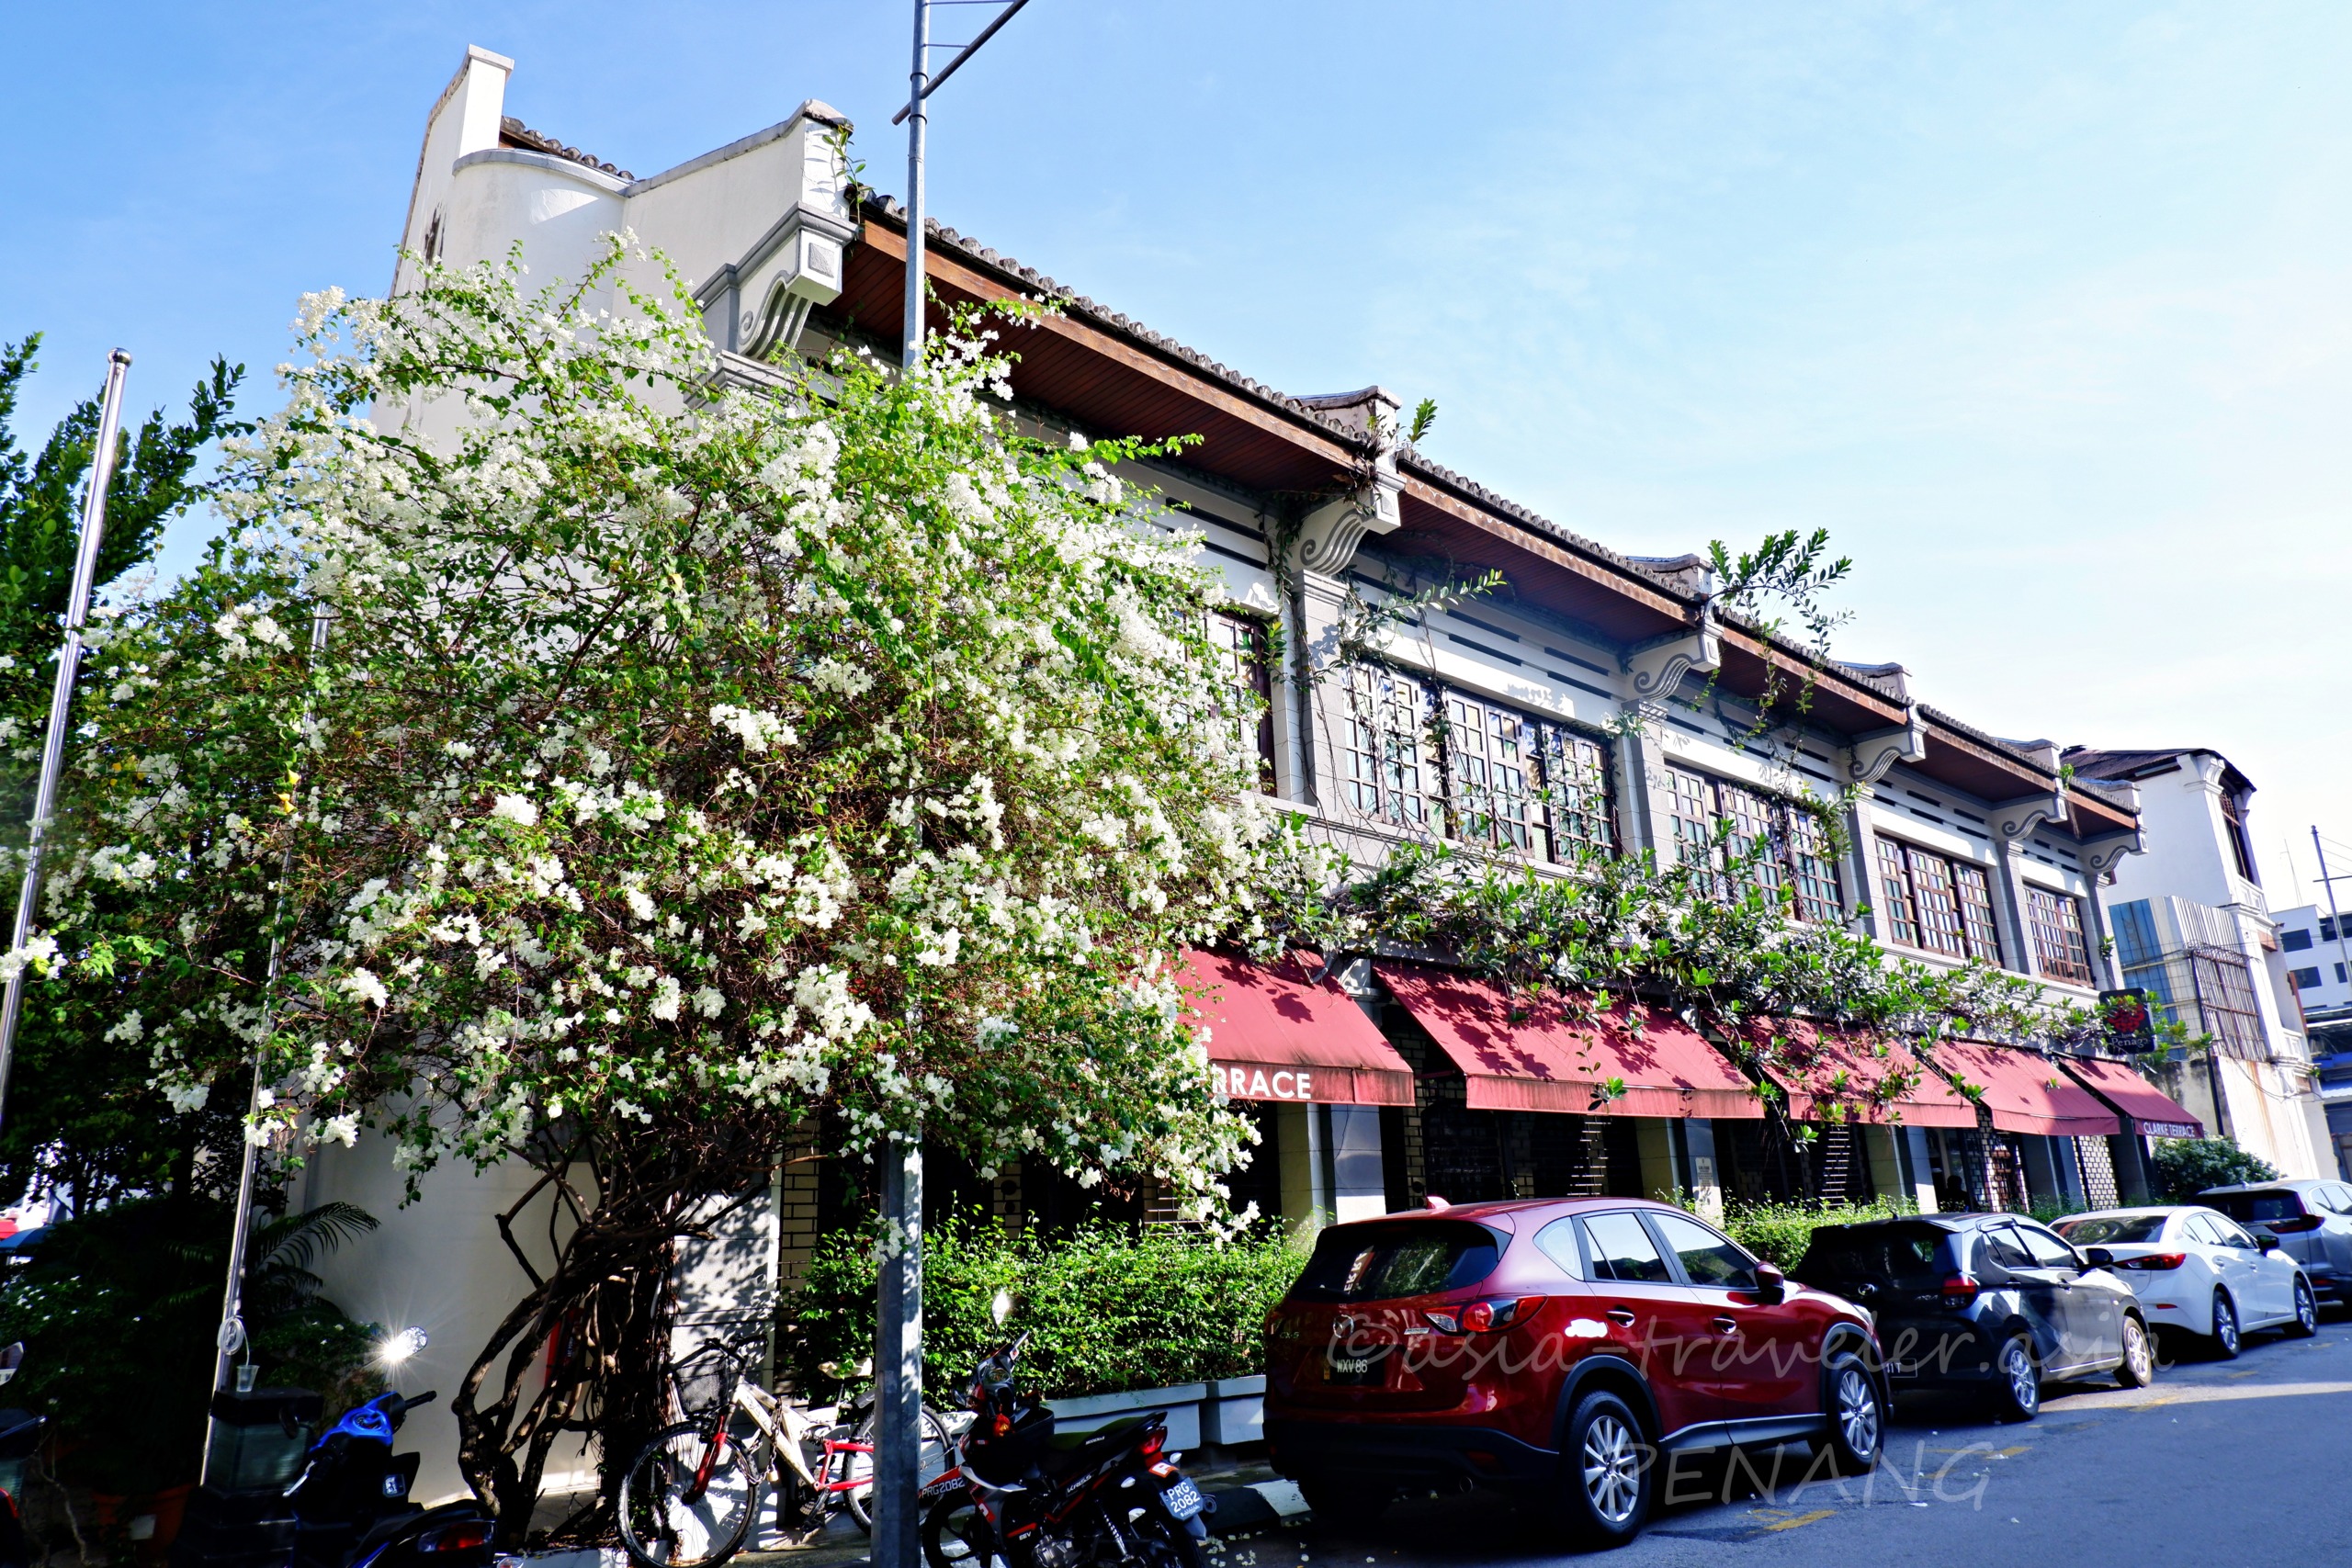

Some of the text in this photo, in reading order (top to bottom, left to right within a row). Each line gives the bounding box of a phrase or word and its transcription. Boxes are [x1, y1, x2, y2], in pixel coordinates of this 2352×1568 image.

[2143, 1122, 2195, 1137] CLARKE TERRACE
[1337, 1359, 1368, 1372] WXV 86
[1170, 1490, 1201, 1514] 2082
